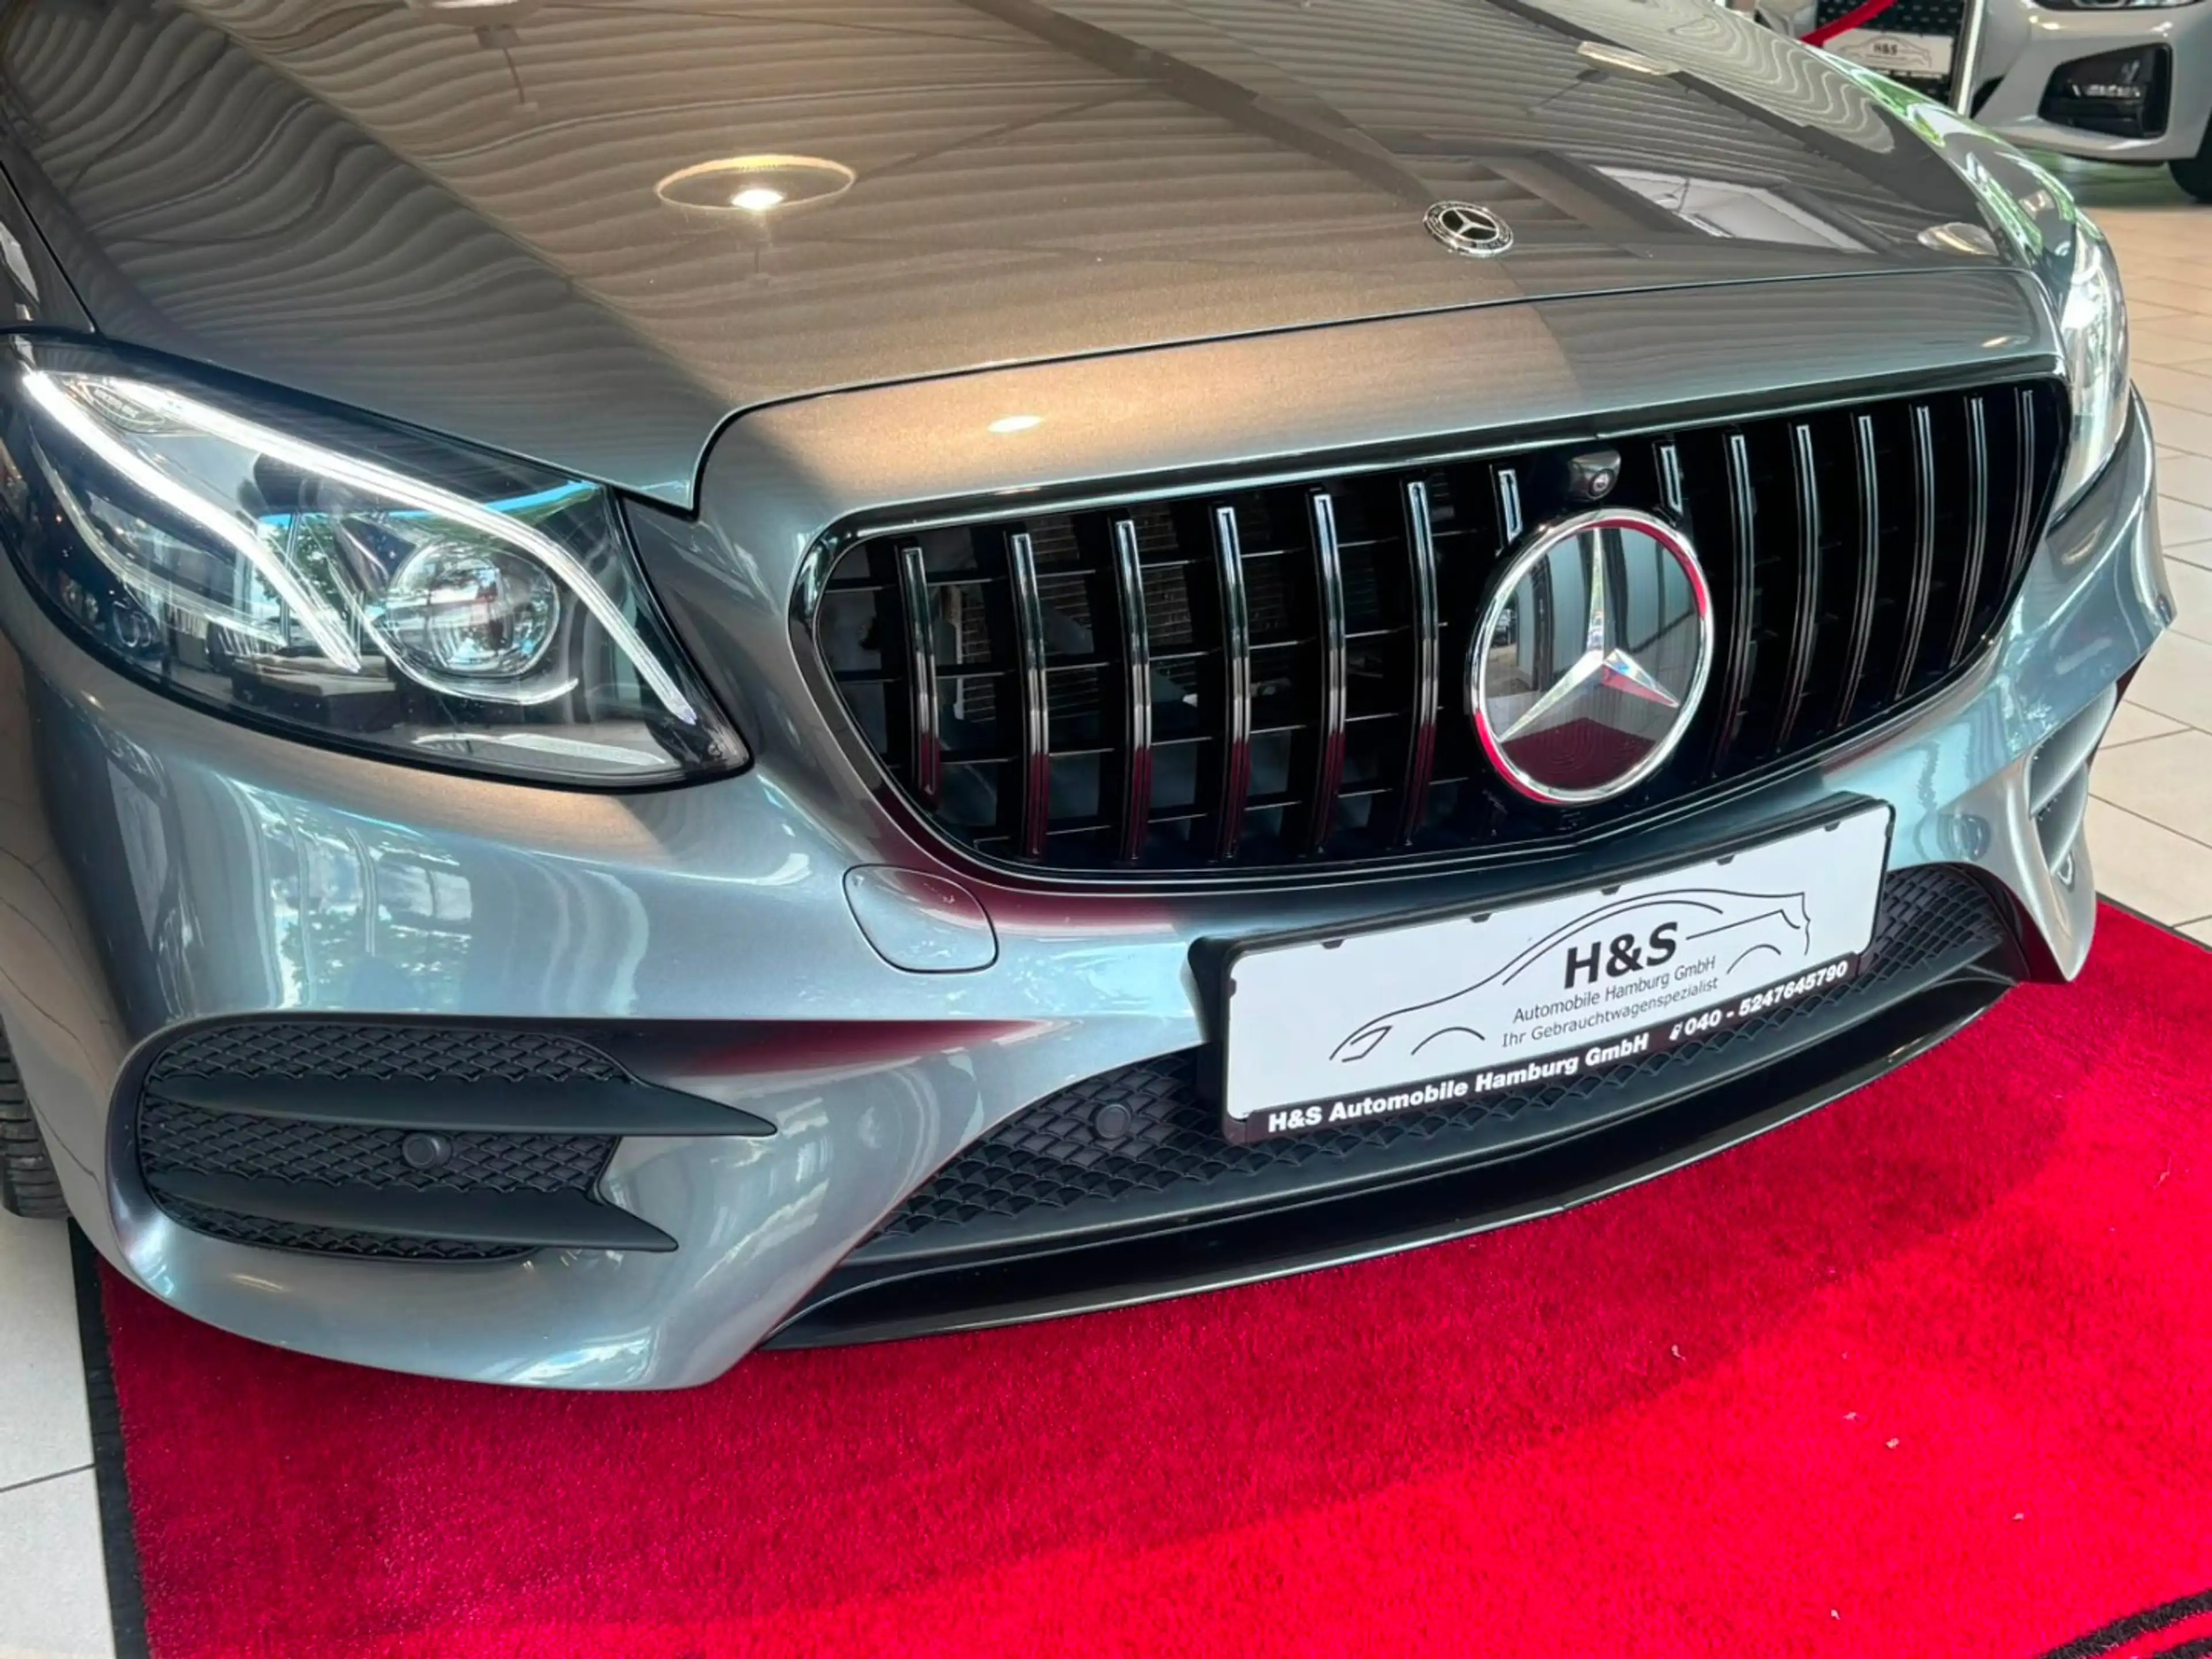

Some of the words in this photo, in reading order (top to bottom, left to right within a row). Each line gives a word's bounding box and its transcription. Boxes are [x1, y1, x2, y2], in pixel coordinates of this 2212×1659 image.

[1513, 991, 1600, 1024] Automobile
[1605, 972, 1670, 1002] Hamburg
[1675, 955, 1716, 981] GmbH
[1564, 921, 1678, 989] H&S
[1268, 1105, 1323, 1133] H&S
[1328, 1080, 1469, 1122] Automobile
[1475, 1056, 1580, 1092] Hamburg
[1585, 1032, 1650, 1067] GmbH
[1684, 1009, 1722, 1036] 040
[1738, 960, 1849, 1017] 5247645790
[1501, 1030, 1527, 1047] Ihr
[1531, 977, 1718, 1041] Gebrauchtwagenspezialist
